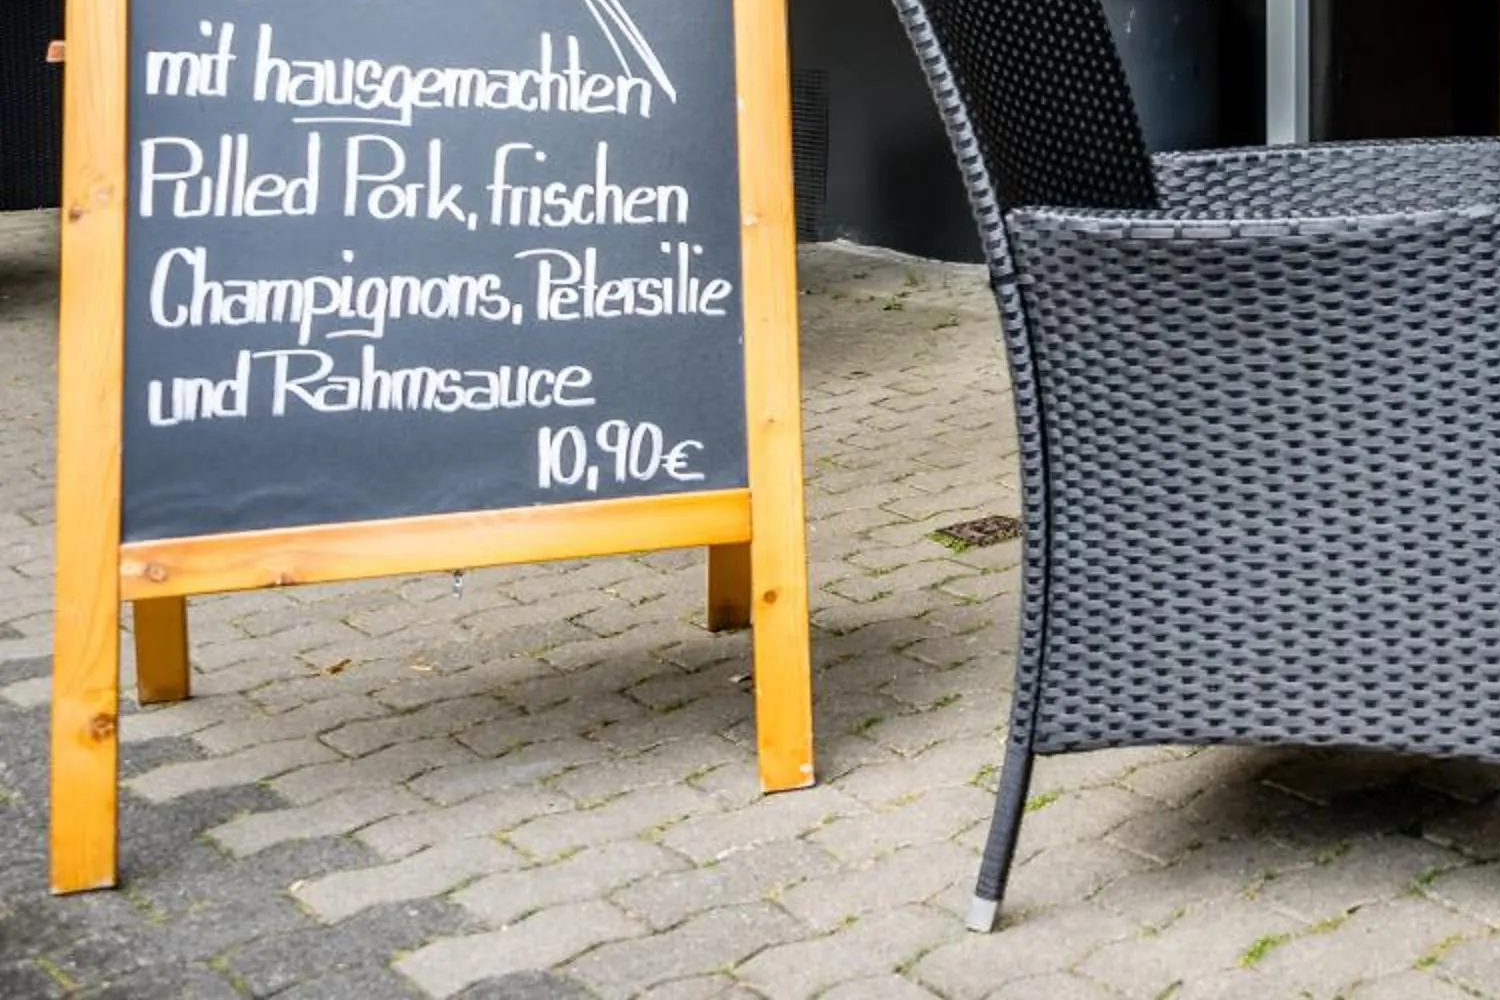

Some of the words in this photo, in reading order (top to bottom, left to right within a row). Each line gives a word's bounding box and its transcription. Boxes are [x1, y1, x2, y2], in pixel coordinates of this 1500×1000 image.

[146, 20, 237, 98] mit
[252, 23, 651, 126] hausgemachten
[139, 131, 320, 218] Pulled
[343, 133, 478, 231] Pork,
[487, 140, 689, 227] frischen
[149, 244, 523, 346] Champignons,
[513, 240, 733, 322] Petersilie
[147, 348, 251, 426] und
[252, 345, 596, 417] Rahmsauce
[537, 419, 706, 492] 10,90€
